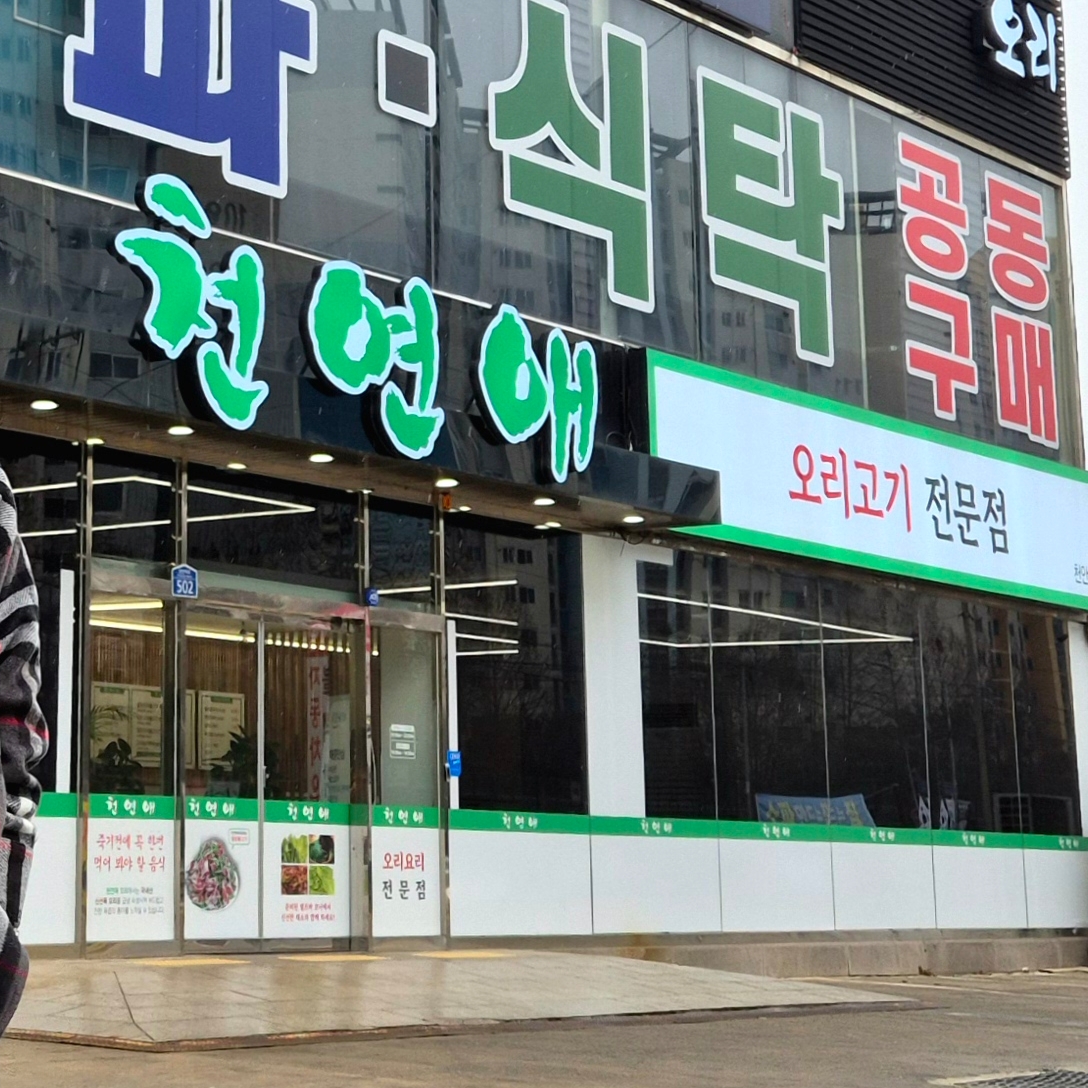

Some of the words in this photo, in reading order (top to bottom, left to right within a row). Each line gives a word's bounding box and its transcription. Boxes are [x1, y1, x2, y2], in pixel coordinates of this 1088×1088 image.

[788, 443, 912, 533] 오리고기
[924, 472, 1009, 554] 전문점
[176, 579, 194, 595] 502
[93, 855, 111, 873] 먹어
[148, 855, 166, 873] 음식
[382, 851, 425, 872] 오리요리
[382, 879, 426, 901] 전문점
